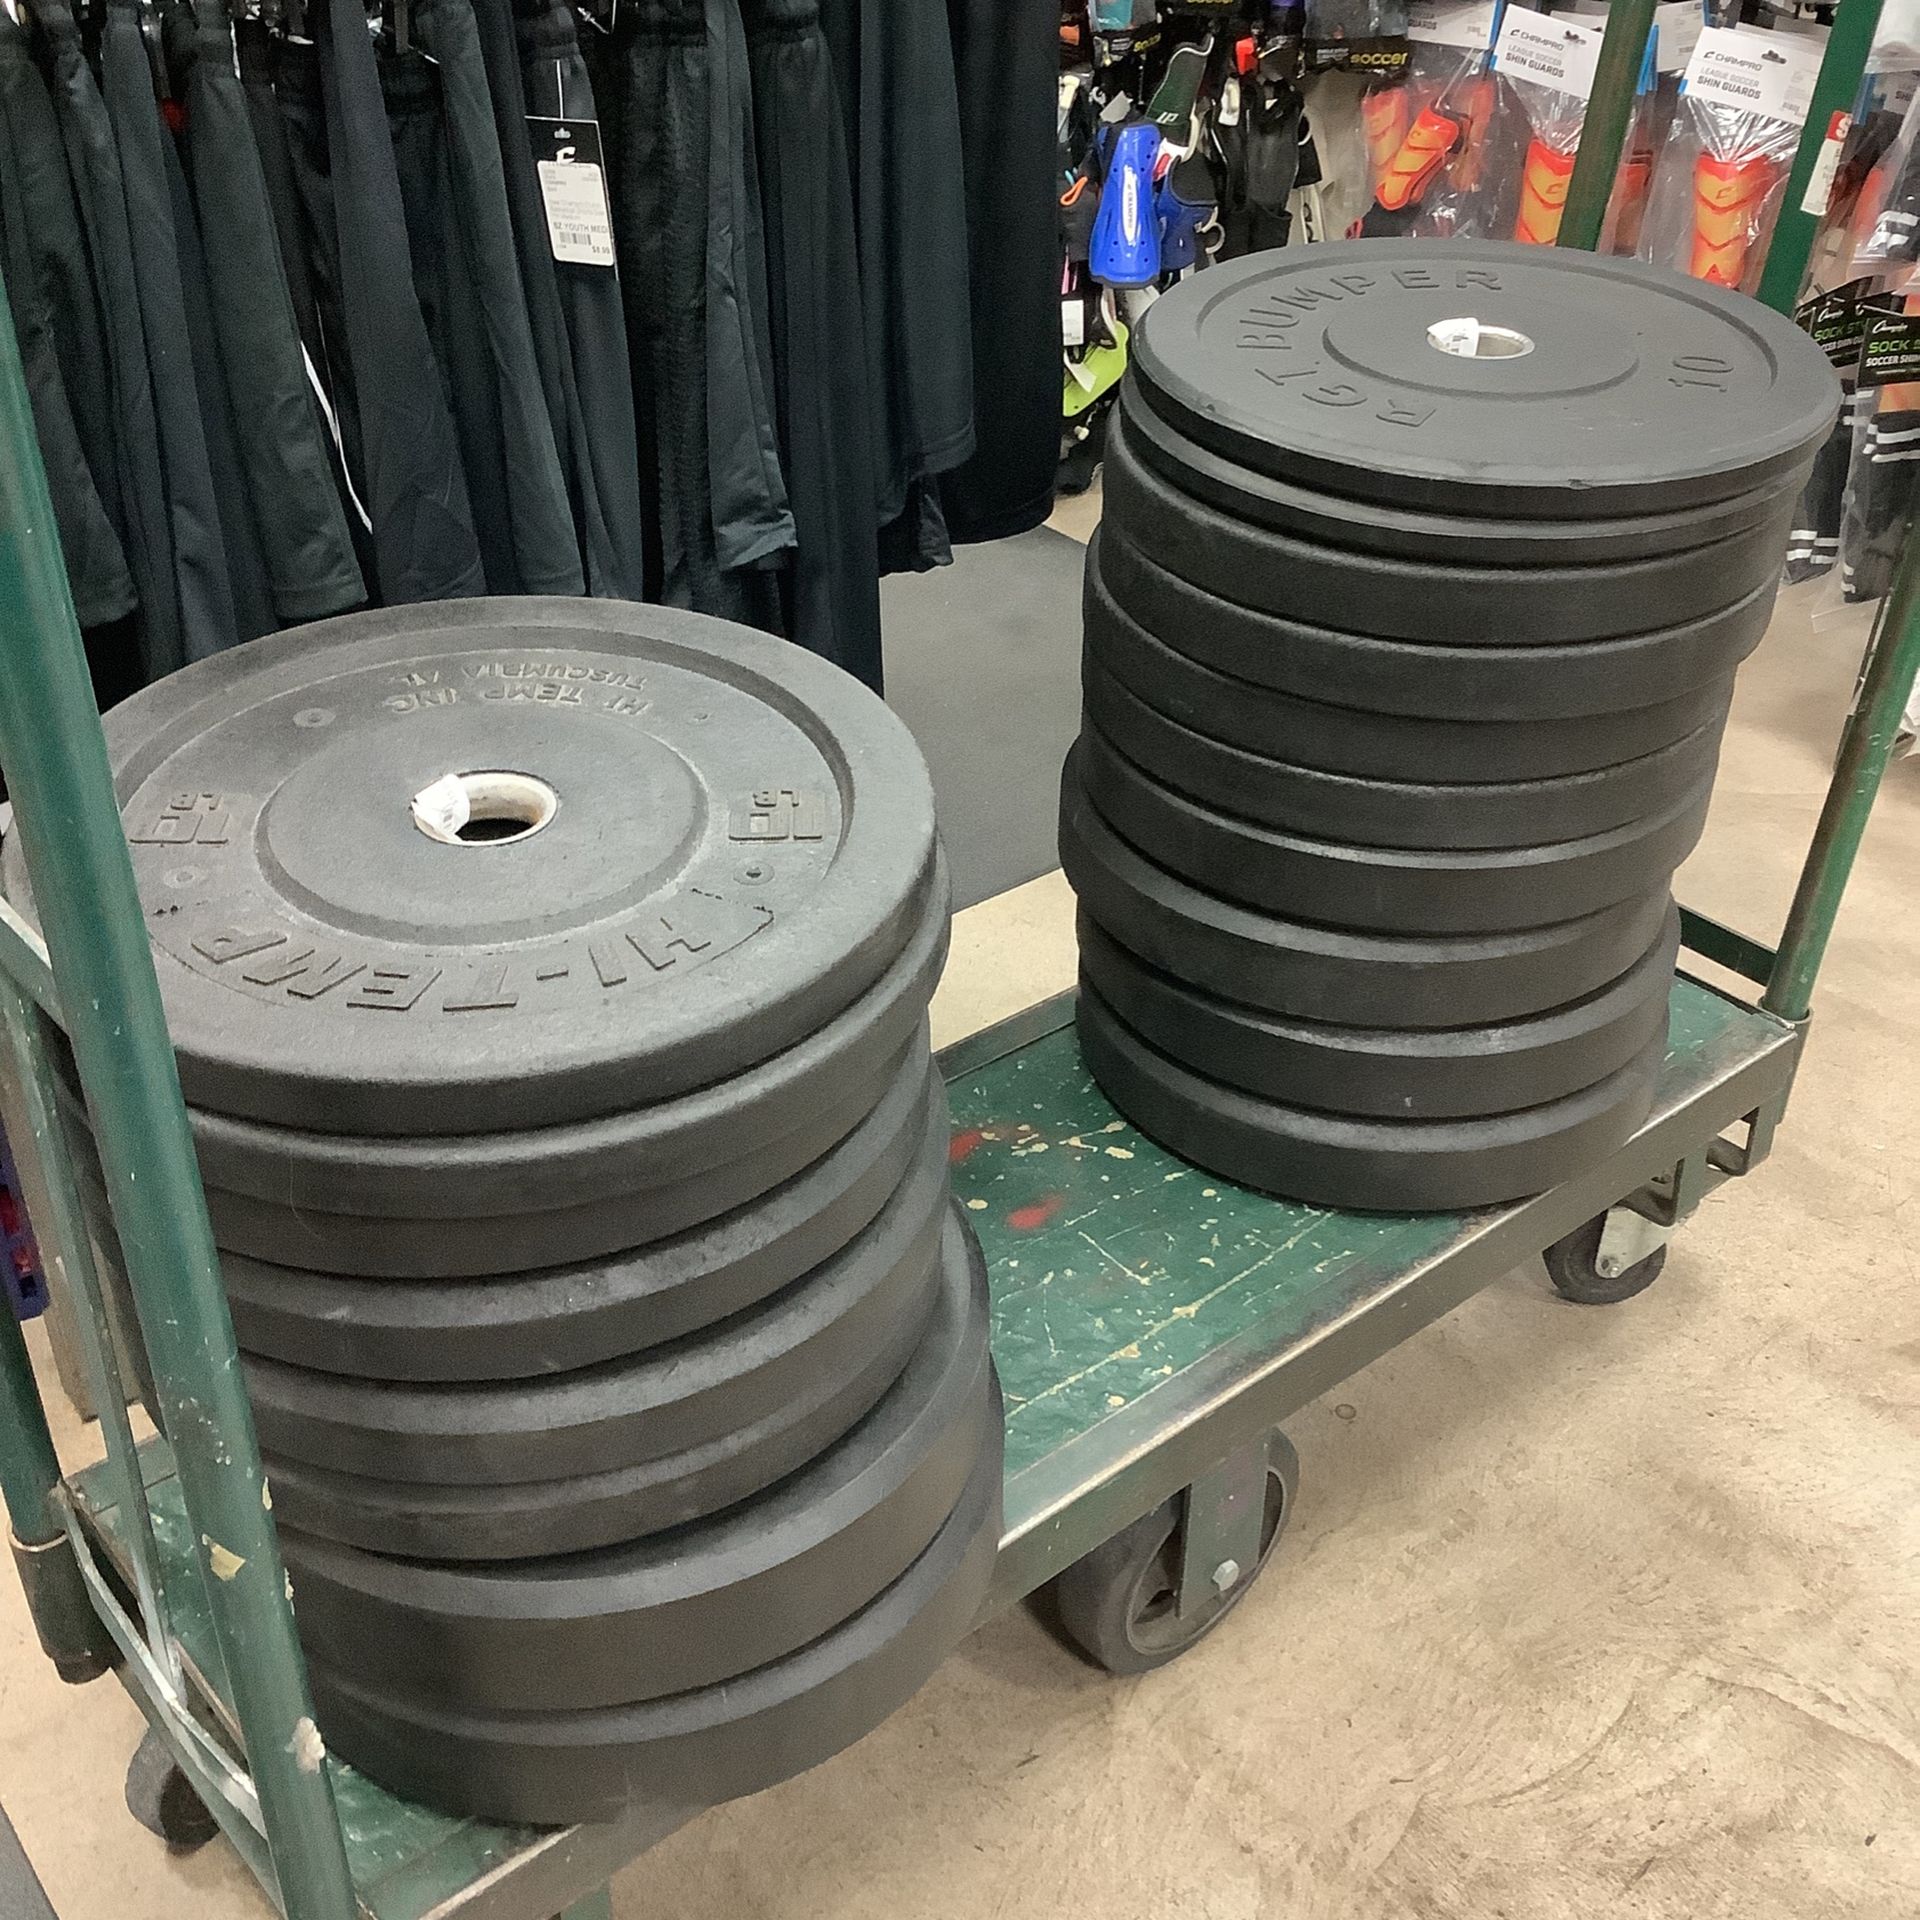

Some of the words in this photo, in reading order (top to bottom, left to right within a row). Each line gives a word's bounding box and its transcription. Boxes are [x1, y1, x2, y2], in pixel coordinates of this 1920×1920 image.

[1521, 31, 1564, 51] CHAMPRO
[1350, 52, 1408, 65] soccer
[1505, 52, 1527, 66] SHIN
[1528, 61, 1565, 78] GUARDS
[1508, 44, 1534, 58] LEAGUE
[1535, 52, 1562, 66] SOCCER
[1715, 53, 1762, 72] CHAMPRO
[1697, 75, 1720, 89] SHIN
[1721, 82, 1762, 100] GUARDS
[1700, 66, 1729, 80] LEAGUE
[1730, 73, 1760, 87] SOCCER
[564, 223, 590, 233] YOUTH
[1236, 269, 1502, 350] BUMPER
[1814, 325, 1844, 341] SOCK
[1868, 339, 1911, 354] SOCK
[1866, 355, 1899, 367] SOCCER
[1667, 355, 1735, 392] 10
[462, 662, 648, 691] TUSCUMBIA
[384, 687, 458, 714] INC
[484, 682, 585, 704] TEMP
[604, 693, 651, 716] HI
[752, 788, 801, 808] LB
[190, 916, 712, 1013] HI-TEMP
